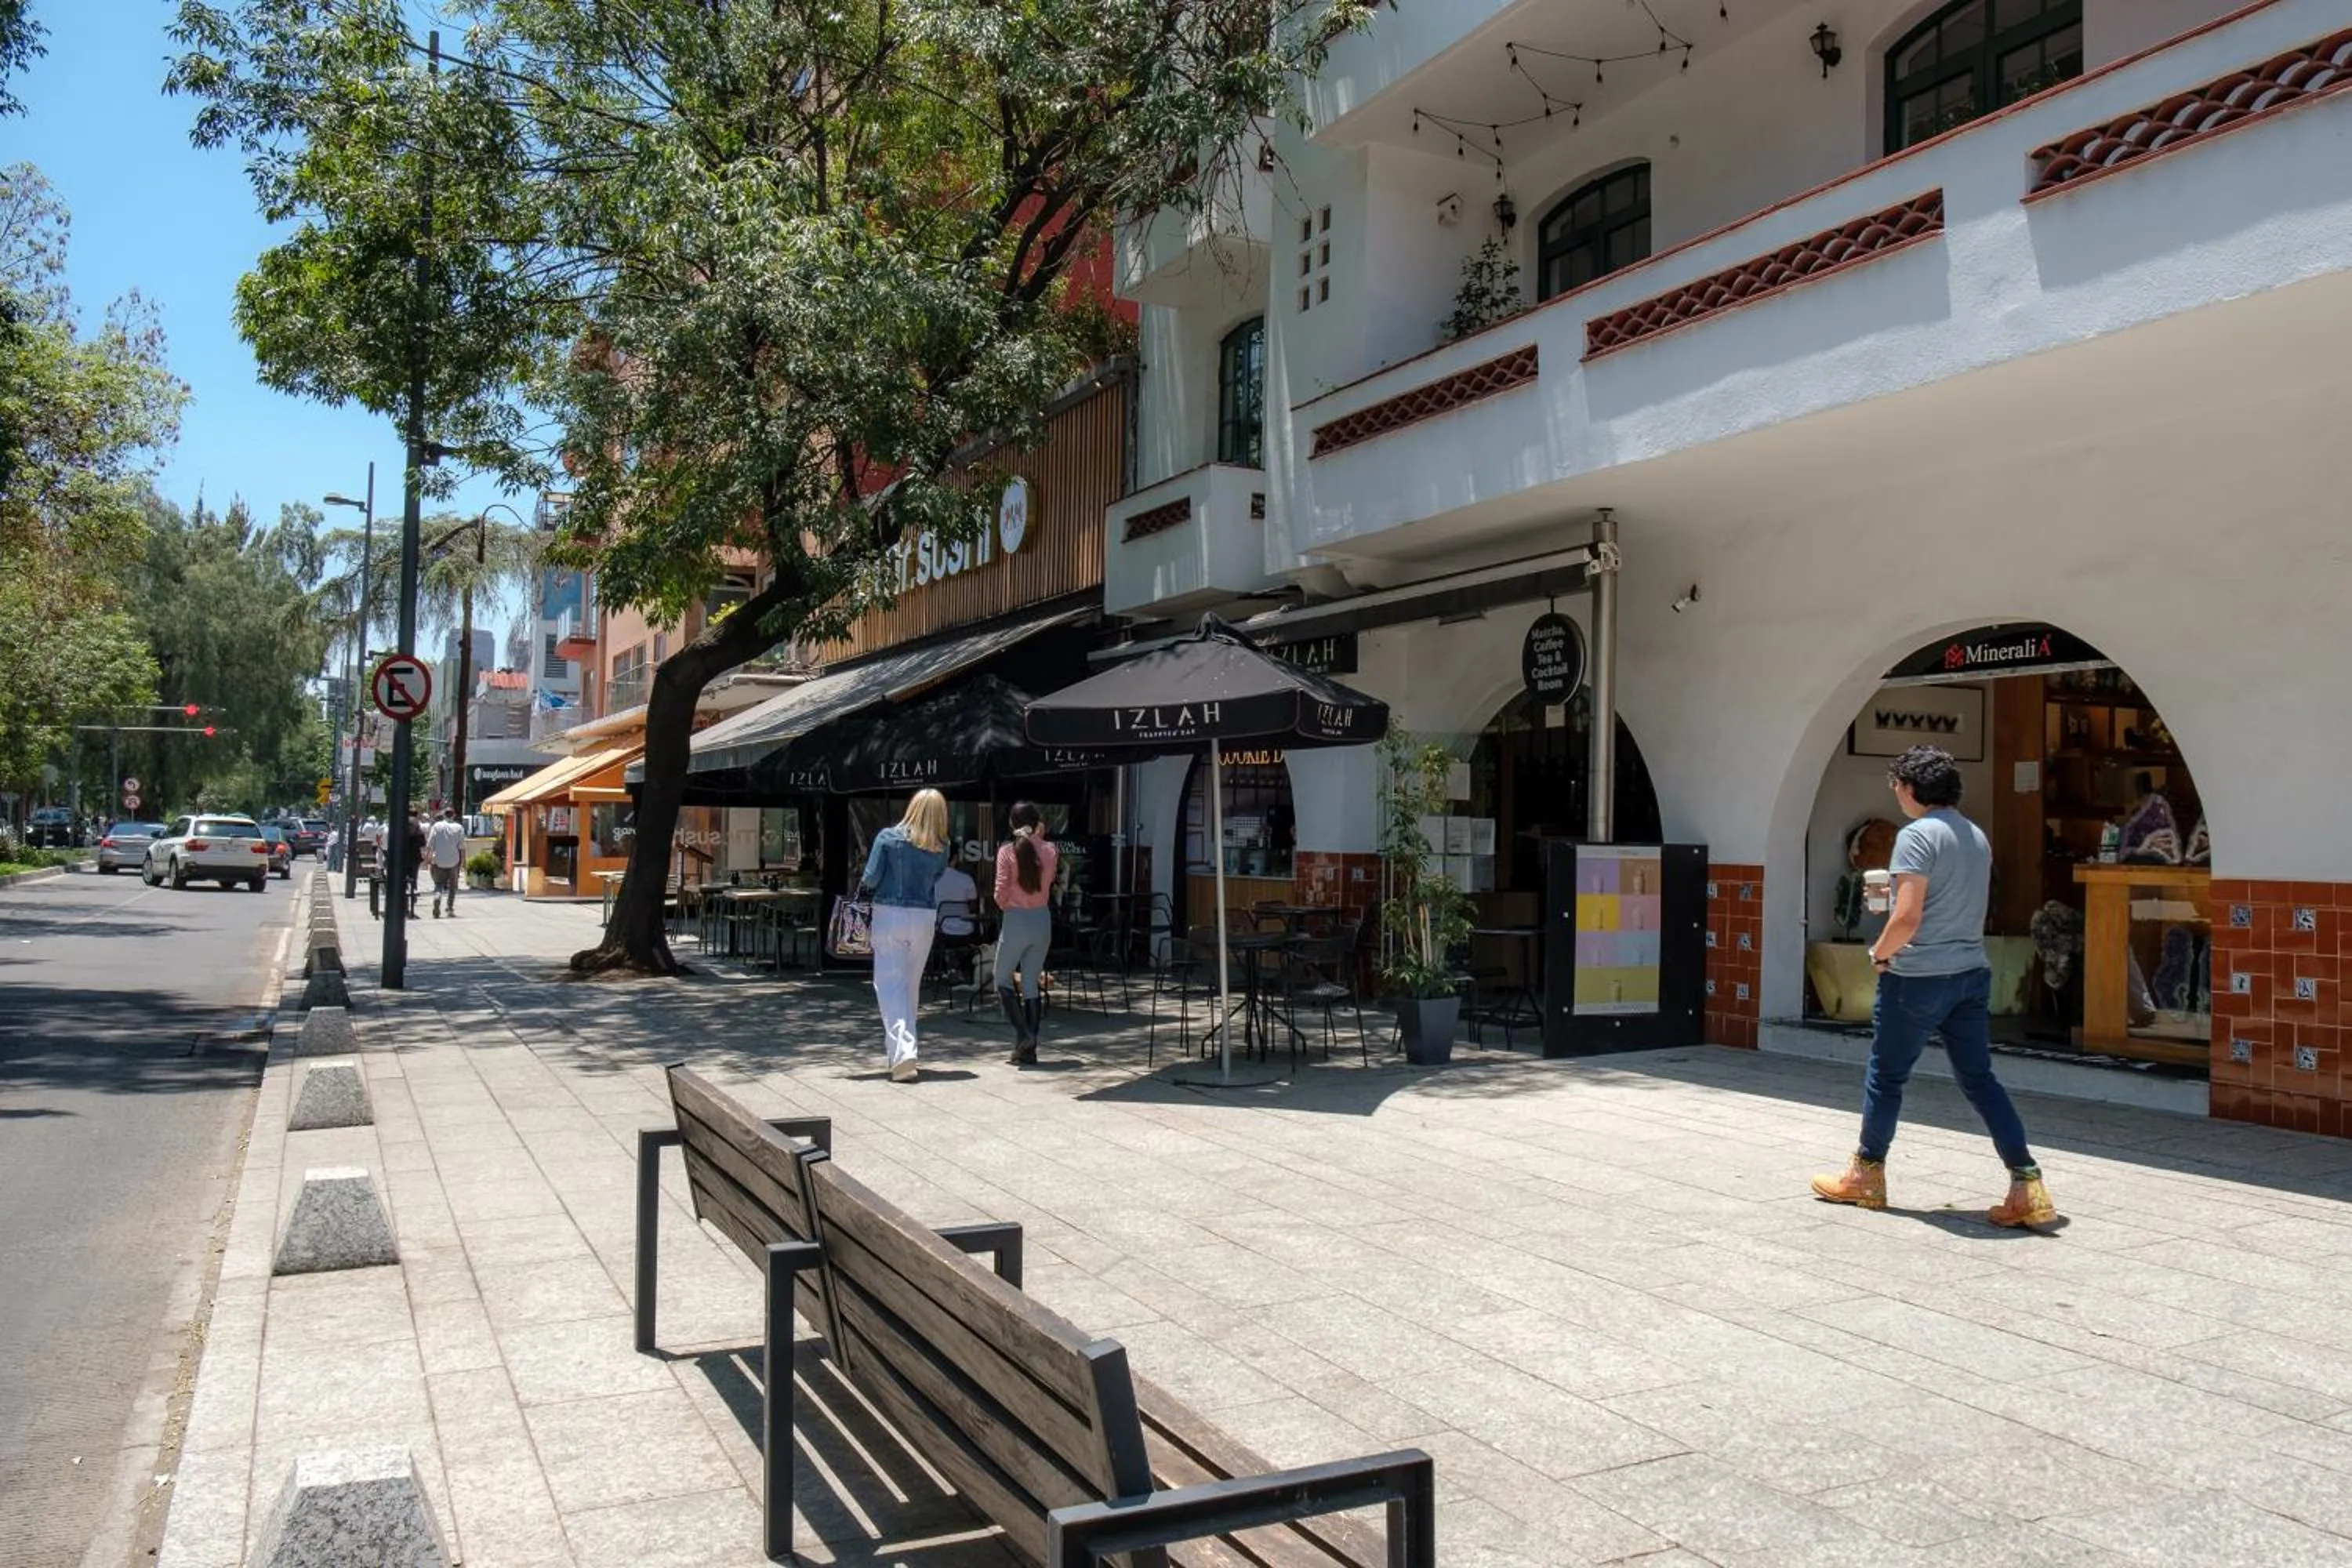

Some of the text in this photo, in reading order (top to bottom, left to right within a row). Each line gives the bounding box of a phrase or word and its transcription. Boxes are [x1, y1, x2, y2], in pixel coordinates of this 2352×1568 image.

[1270, 639, 1334, 665] ZLAH
[1534, 639, 1564, 652] Coffee
[1537, 653, 1553, 666] Tea
[1531, 662, 1569, 679] Cocktail
[1537, 679, 1563, 691] Room
[1113, 702, 1220, 730] IZLAH
[1317, 704, 1352, 728] IZLAH
[880, 758, 937, 779] IZLAH
[789, 771, 827, 786] IZLA
